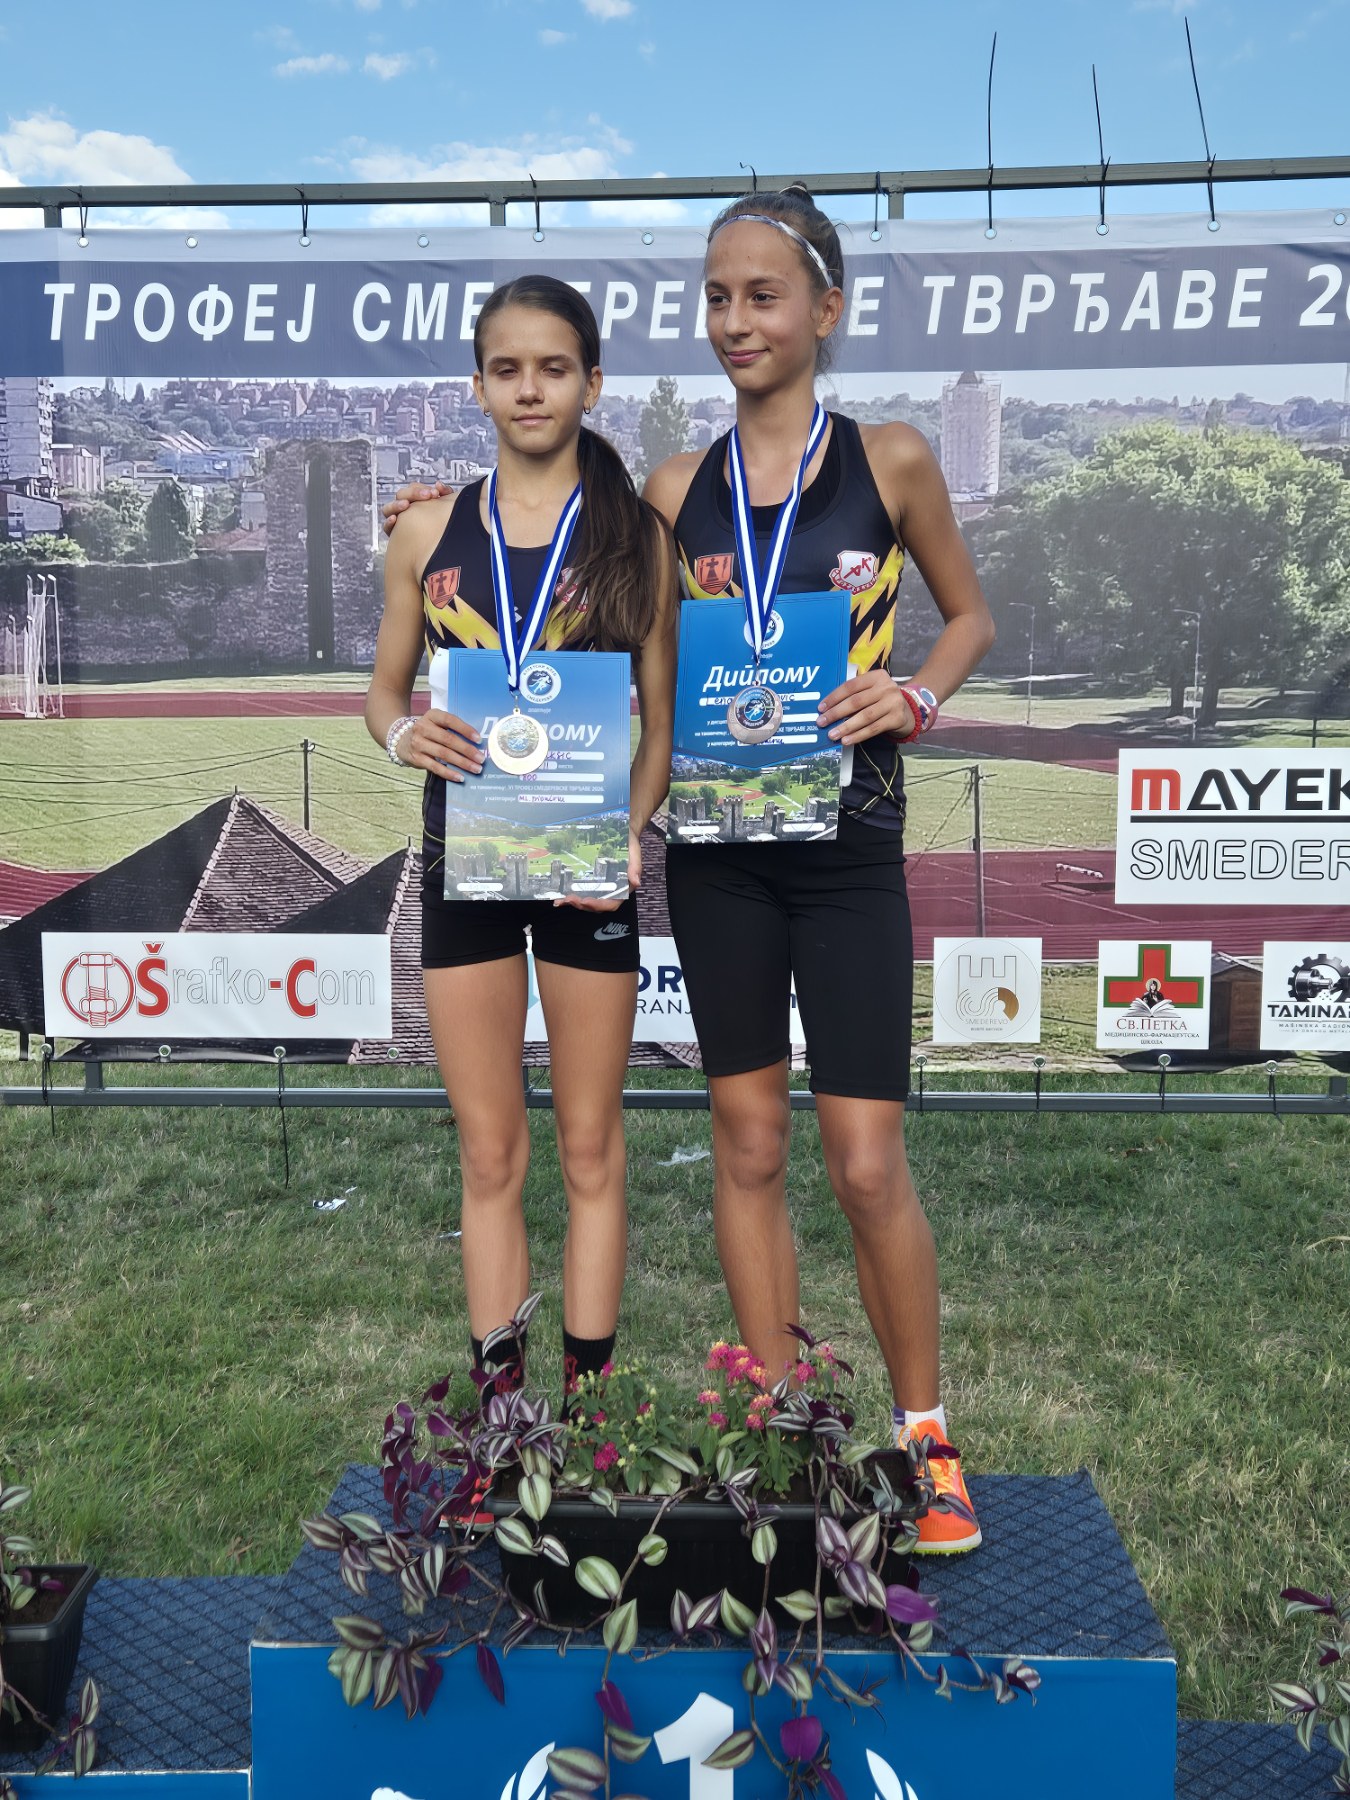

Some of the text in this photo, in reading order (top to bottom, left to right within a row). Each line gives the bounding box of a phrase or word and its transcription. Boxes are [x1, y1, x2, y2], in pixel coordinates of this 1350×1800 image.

[43, 263, 1350, 343] ТРОФЕЈ СМЕРЕЕ ТВРЂАВЕ 2
[480, 716, 602, 747] Дому
[603, 922, 629, 934] NIKE
[135, 941, 375, 1019] Šrafko-Com
[1267, 1004, 1350, 1018] TAMINA
[653, 1691, 734, 1800] 1
